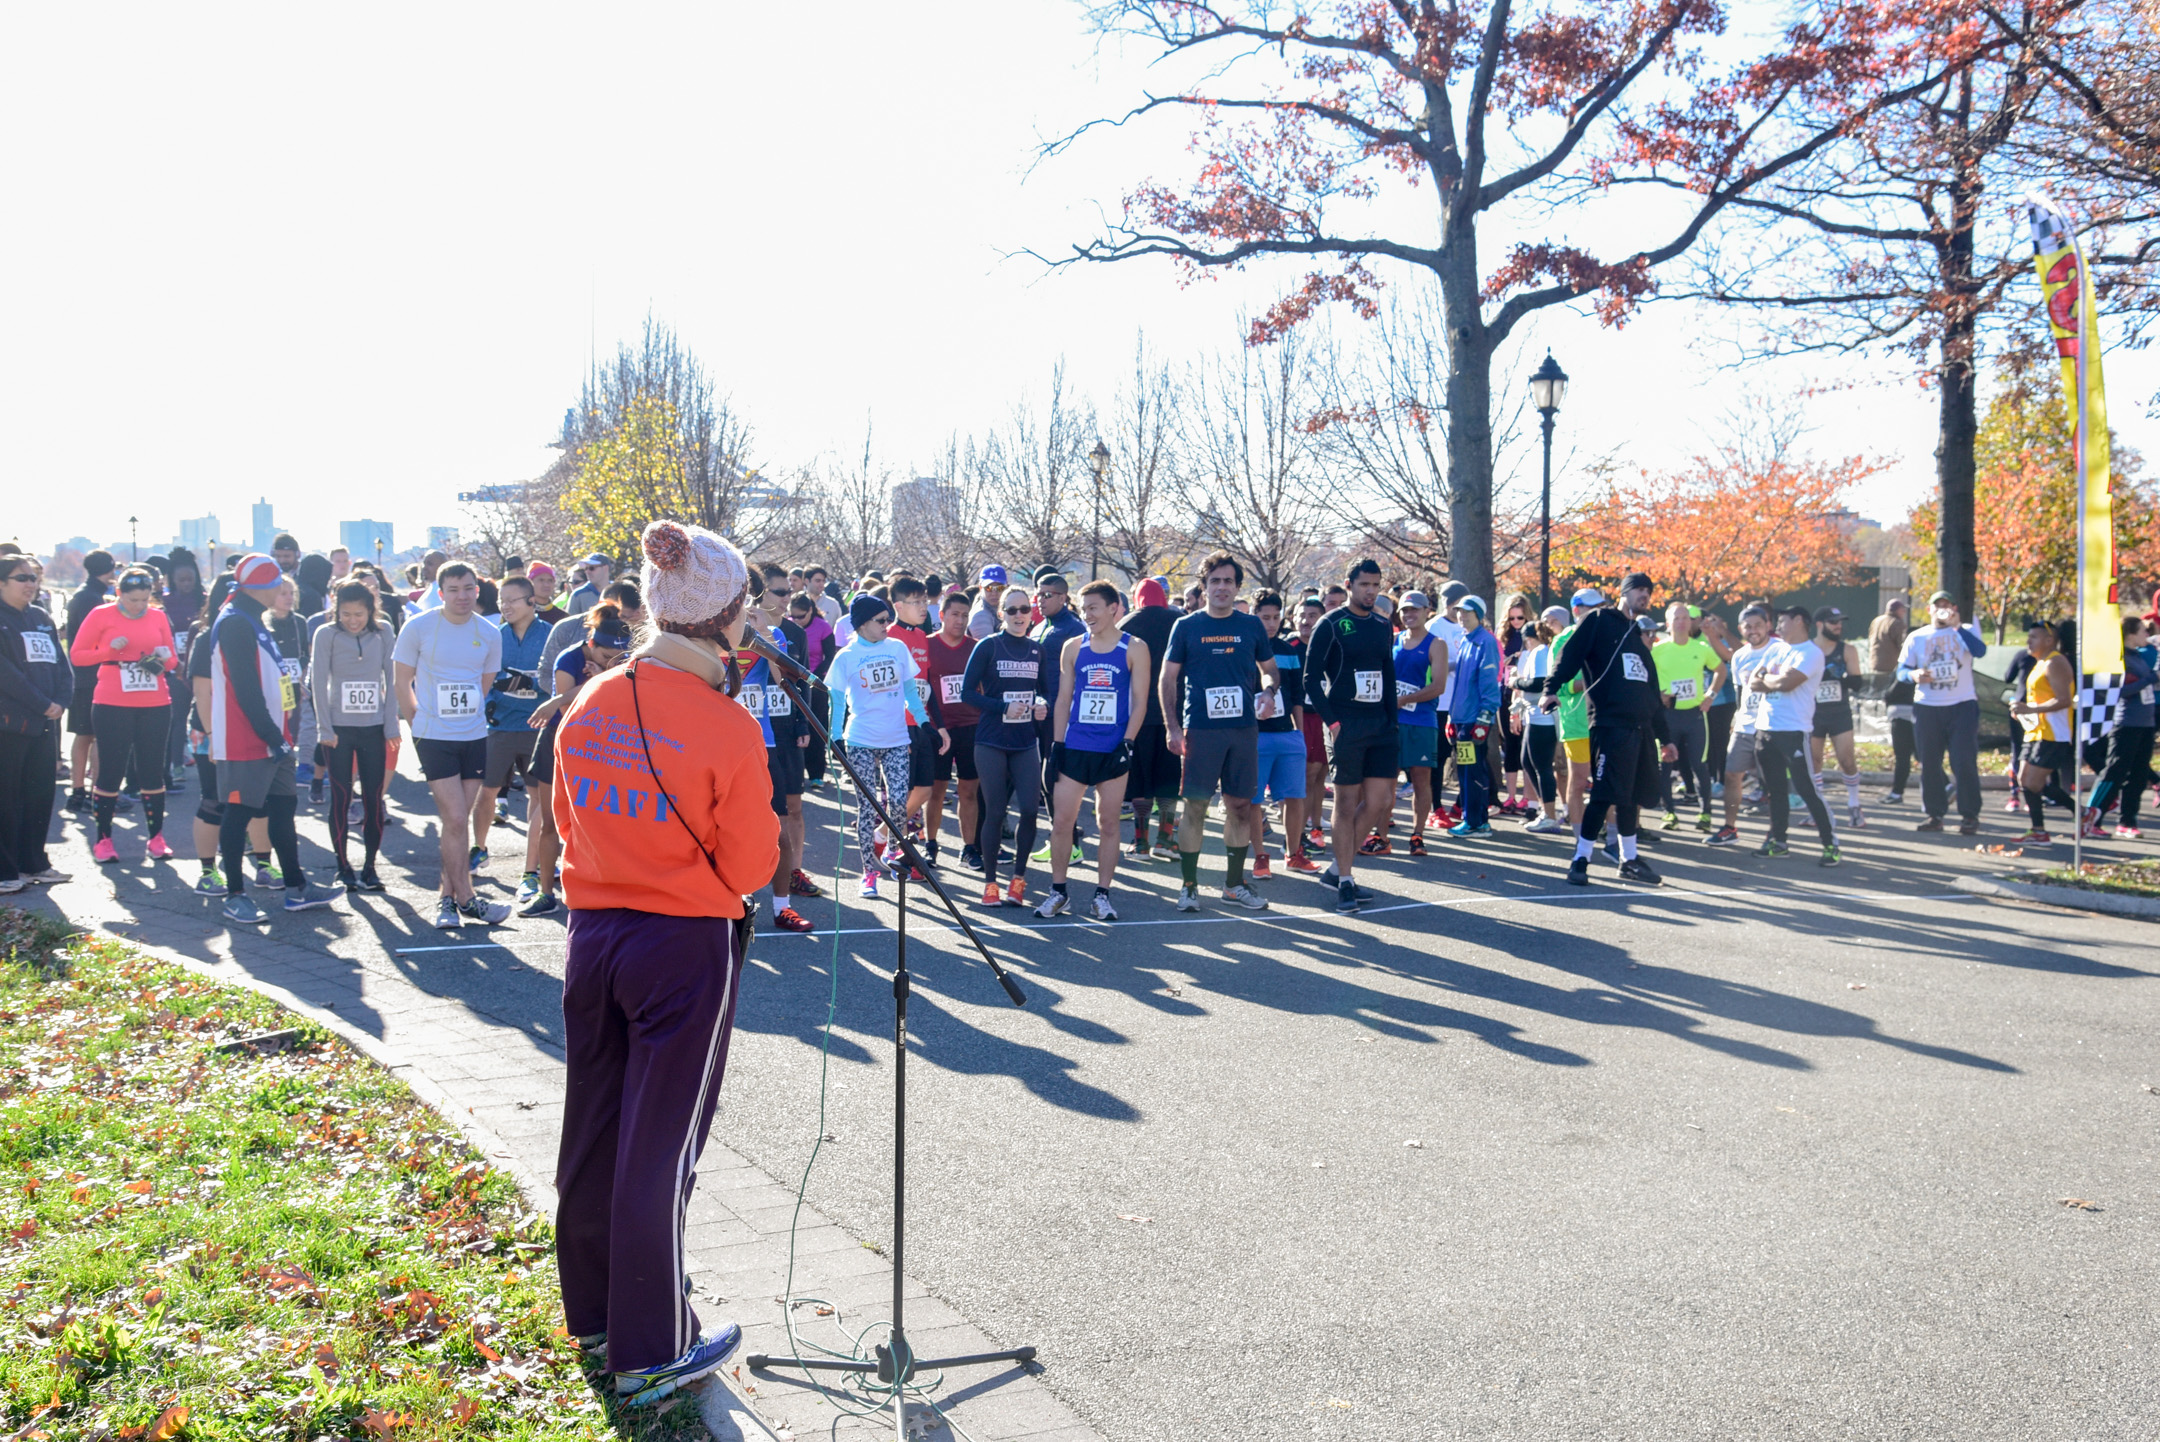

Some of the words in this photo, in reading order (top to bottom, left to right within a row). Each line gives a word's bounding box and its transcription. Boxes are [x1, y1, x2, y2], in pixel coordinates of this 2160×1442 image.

[31, 639, 52, 654] 626
[873, 666, 896, 683] 673
[1081, 663, 1121, 674] WELLINGTON
[1935, 666, 1952, 678] 191
[129, 670, 152, 683] 378
[1366, 679, 1377, 694] 54
[1675, 683, 1693, 696] 249
[1820, 685, 1837, 697] 232
[350, 690, 375, 704] 602
[451, 692, 468, 707] 64
[768, 693, 786, 709] 84
[1213, 695, 1237, 709] 261
[1090, 700, 1106, 715] 27
[565, 706, 685, 754] Self-Transcendence
[585, 740, 603, 751] SRI
[607, 731, 651, 750] RACES
[1457, 747, 1470, 758] 51
[566, 746, 632, 770] MARATHON
[637, 763, 663, 777] TEAM
[564, 772, 678, 822] TAFF
